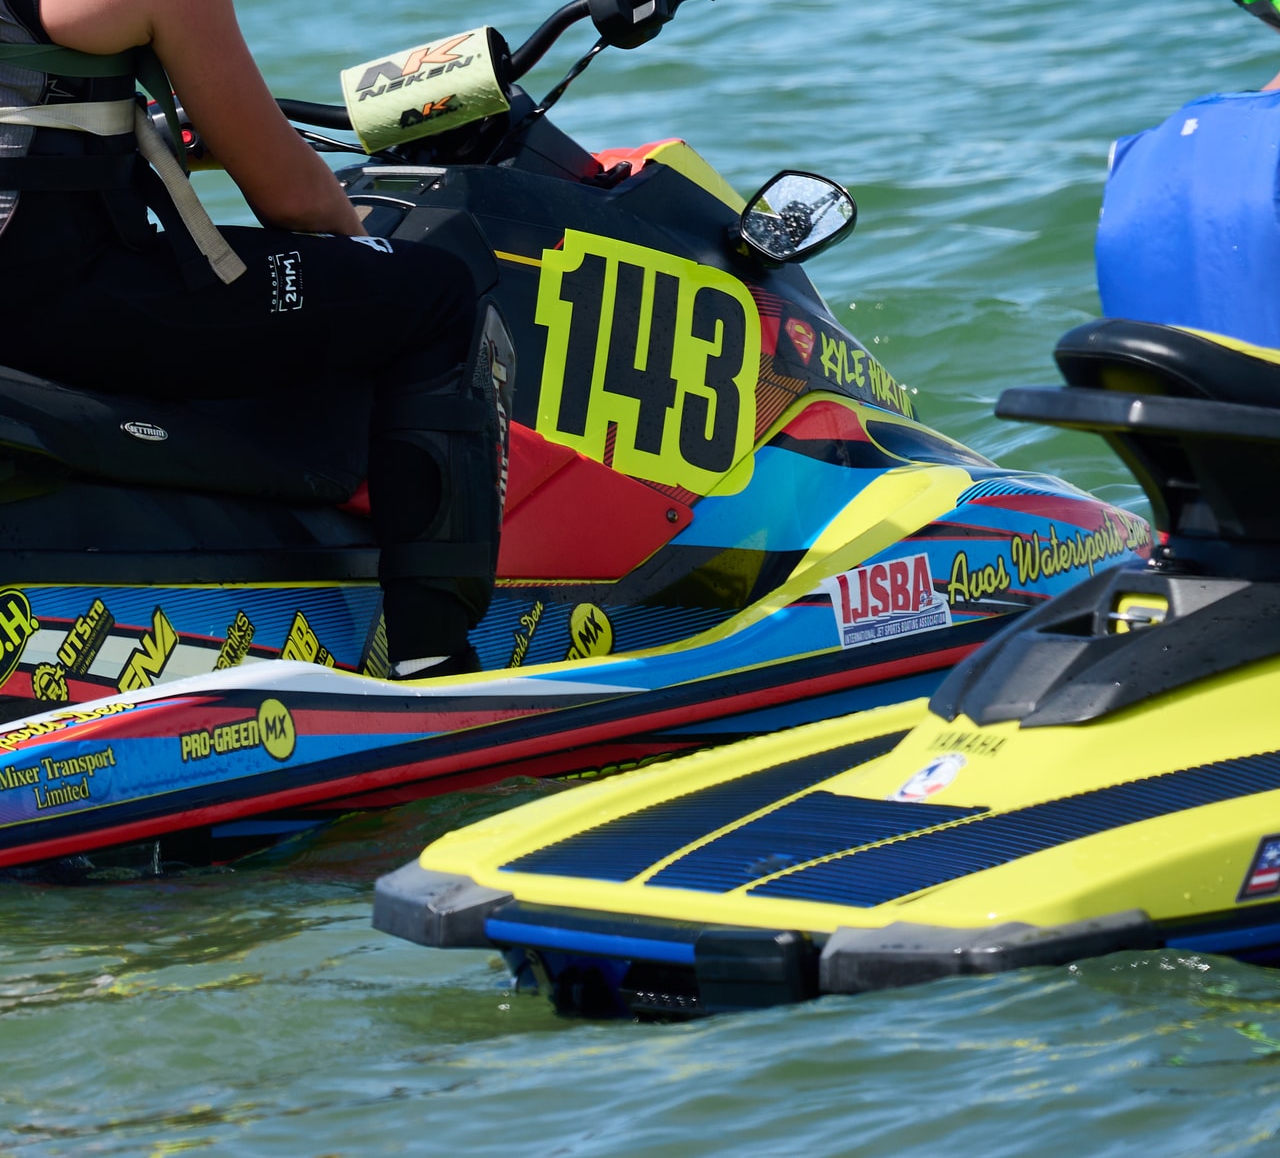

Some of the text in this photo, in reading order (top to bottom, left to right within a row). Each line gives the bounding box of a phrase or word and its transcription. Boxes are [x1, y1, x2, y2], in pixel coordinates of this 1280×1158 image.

[358, 55, 474, 102] NEKEN
[268, 255, 278, 313] TORONTO
[283, 259, 297, 303] 2MM
[555, 253, 746, 473] 143
[820, 331, 866, 388] KYLE
[947, 551, 1010, 605] Avos
[1011, 510, 1124, 586] Watersports
[836, 555, 933, 624] IJSBA
[215, 611, 250, 671] amiks
[578, 607, 604, 653] MX
[844, 611, 946, 645] INTERNATIONAL JET SPORTS BOATING ASSOCIATION
[64, 699, 137, 727] Den
[181, 707, 289, 762] PRO-GREEN MX
[40, 746, 117, 782] Transport
[927, 731, 1008, 759] YAMAHA
[34, 776, 90, 810] Limited
